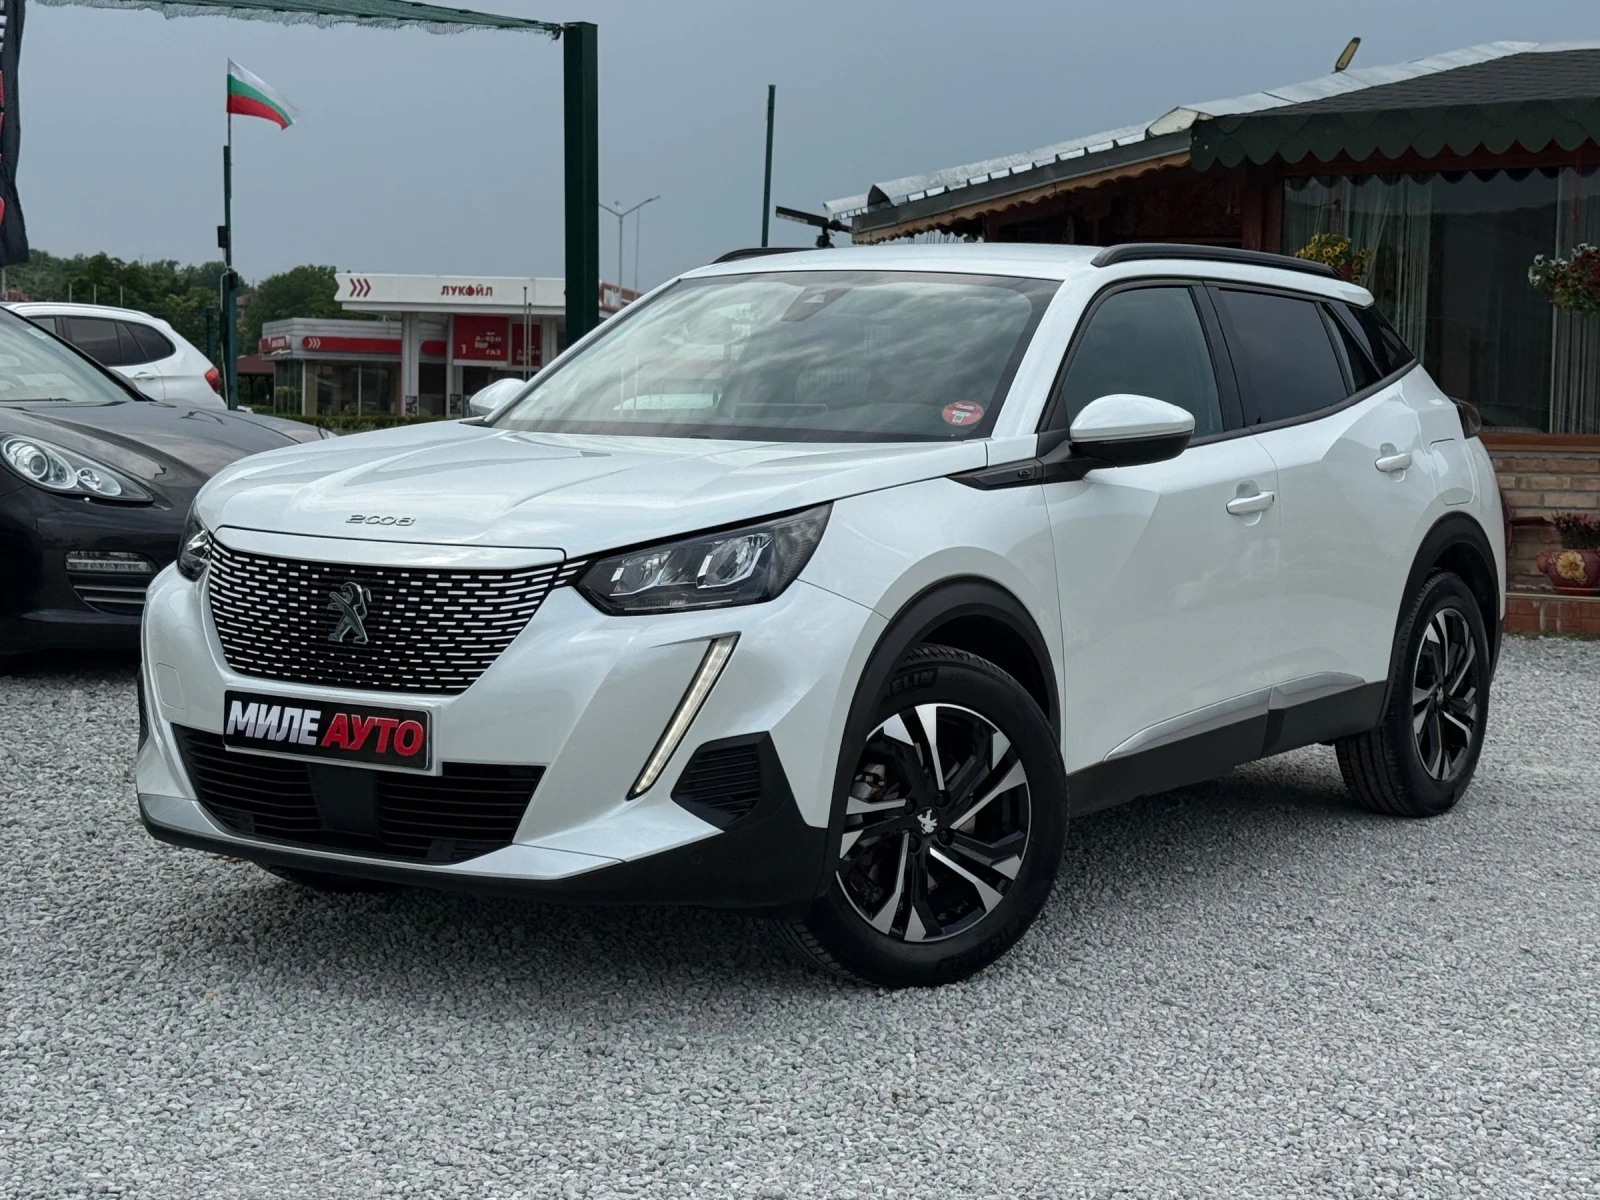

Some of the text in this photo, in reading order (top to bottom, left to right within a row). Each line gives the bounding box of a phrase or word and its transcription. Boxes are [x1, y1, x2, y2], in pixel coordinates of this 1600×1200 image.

[441, 284, 493, 296] ЛУКОЙЛ
[345, 514, 416, 526] 2008
[891, 669, 934, 692] ELIN
[226, 700, 423, 756] МИЛЕ АУТО
